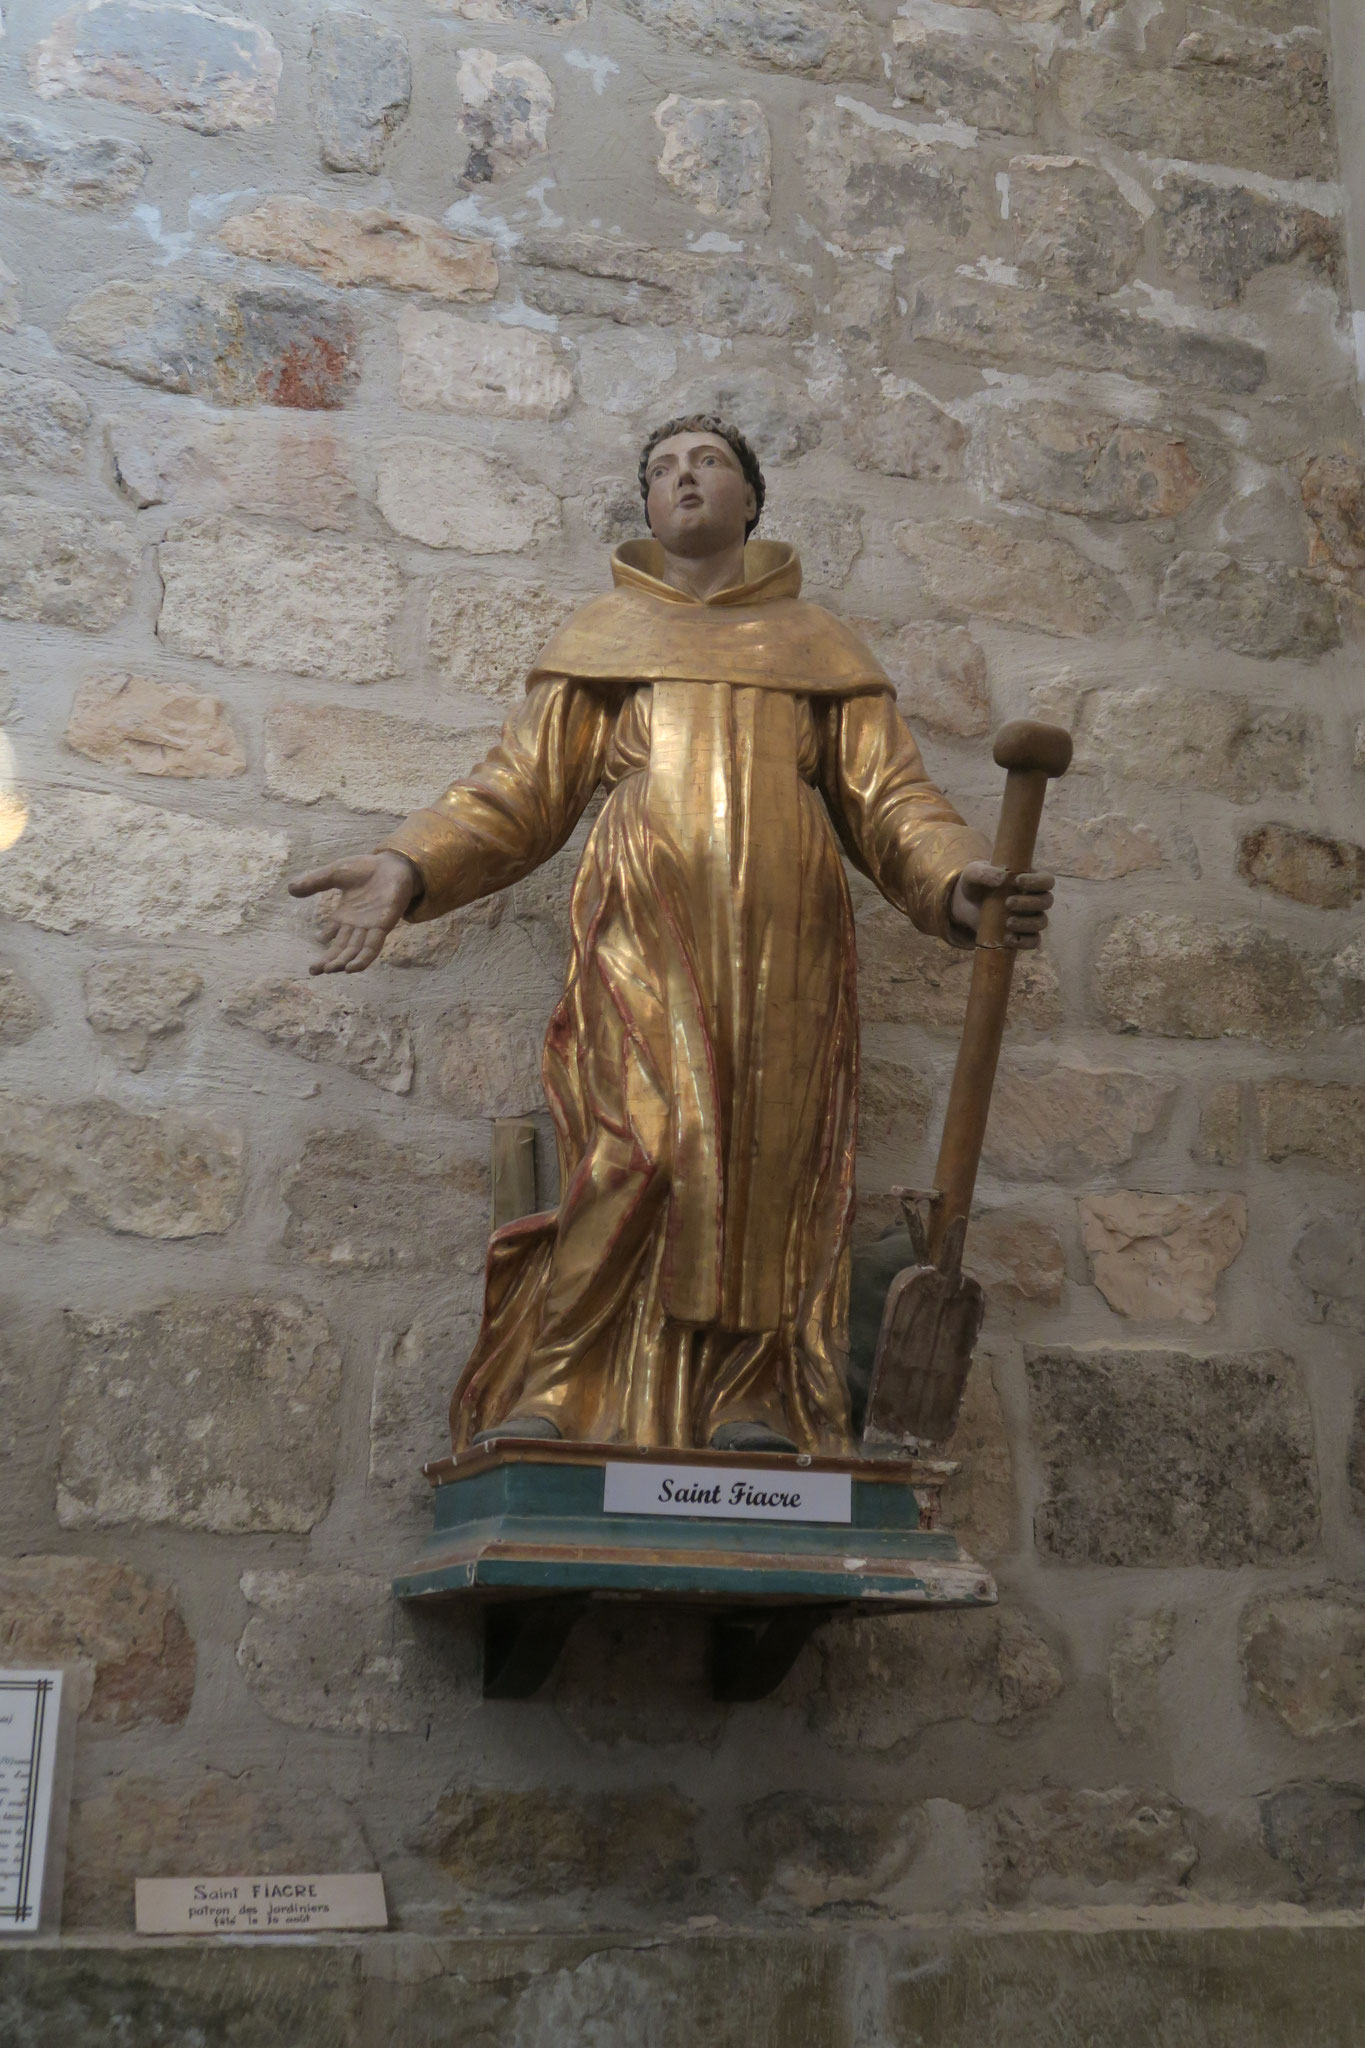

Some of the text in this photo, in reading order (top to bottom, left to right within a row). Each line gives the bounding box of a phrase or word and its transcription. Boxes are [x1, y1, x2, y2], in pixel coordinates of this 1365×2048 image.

[658, 1479, 802, 1508] Saint Fiacre
[193, 1885, 239, 1900] Saint
[188, 1902, 330, 1919] patron des jardiniers
[248, 1914, 258, 1925] le
